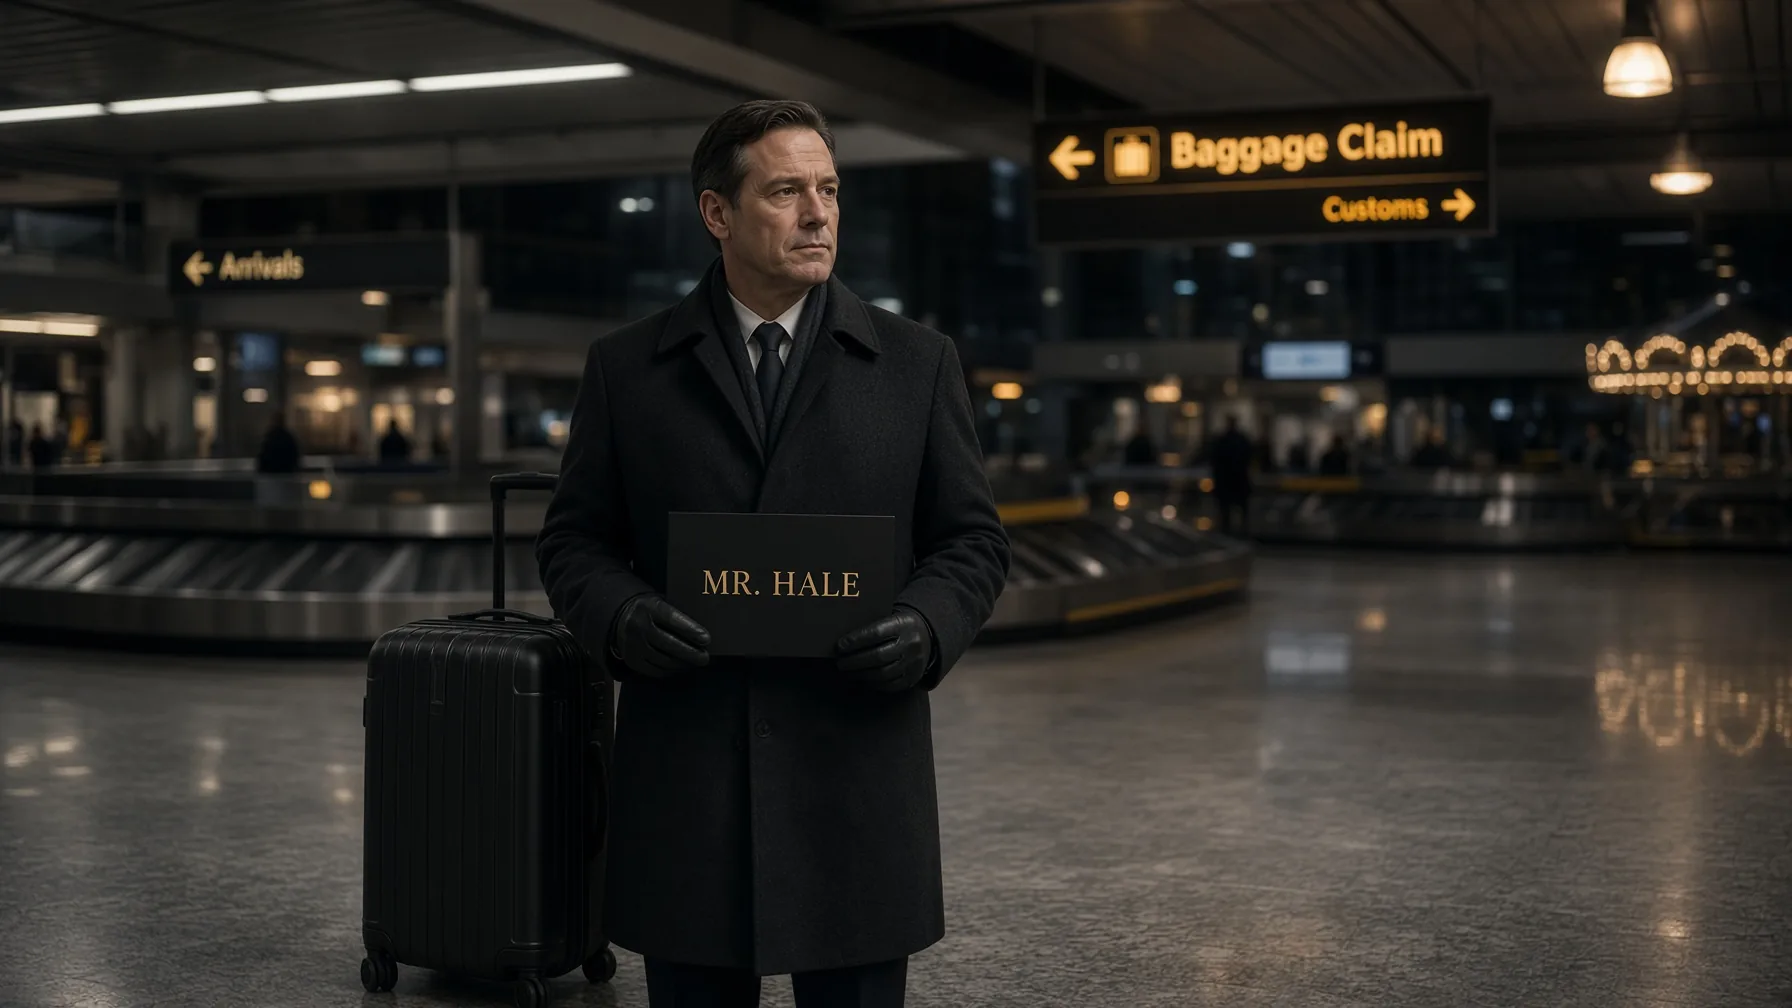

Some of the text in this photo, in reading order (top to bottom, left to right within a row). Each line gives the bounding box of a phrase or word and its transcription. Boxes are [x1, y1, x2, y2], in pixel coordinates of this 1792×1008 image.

[1170, 121, 1443, 176] Baggage Claim
[1322, 195, 1430, 223] Customs
[219, 249, 304, 280] Arrivals
[702, 569, 860, 597] MR. HALE
